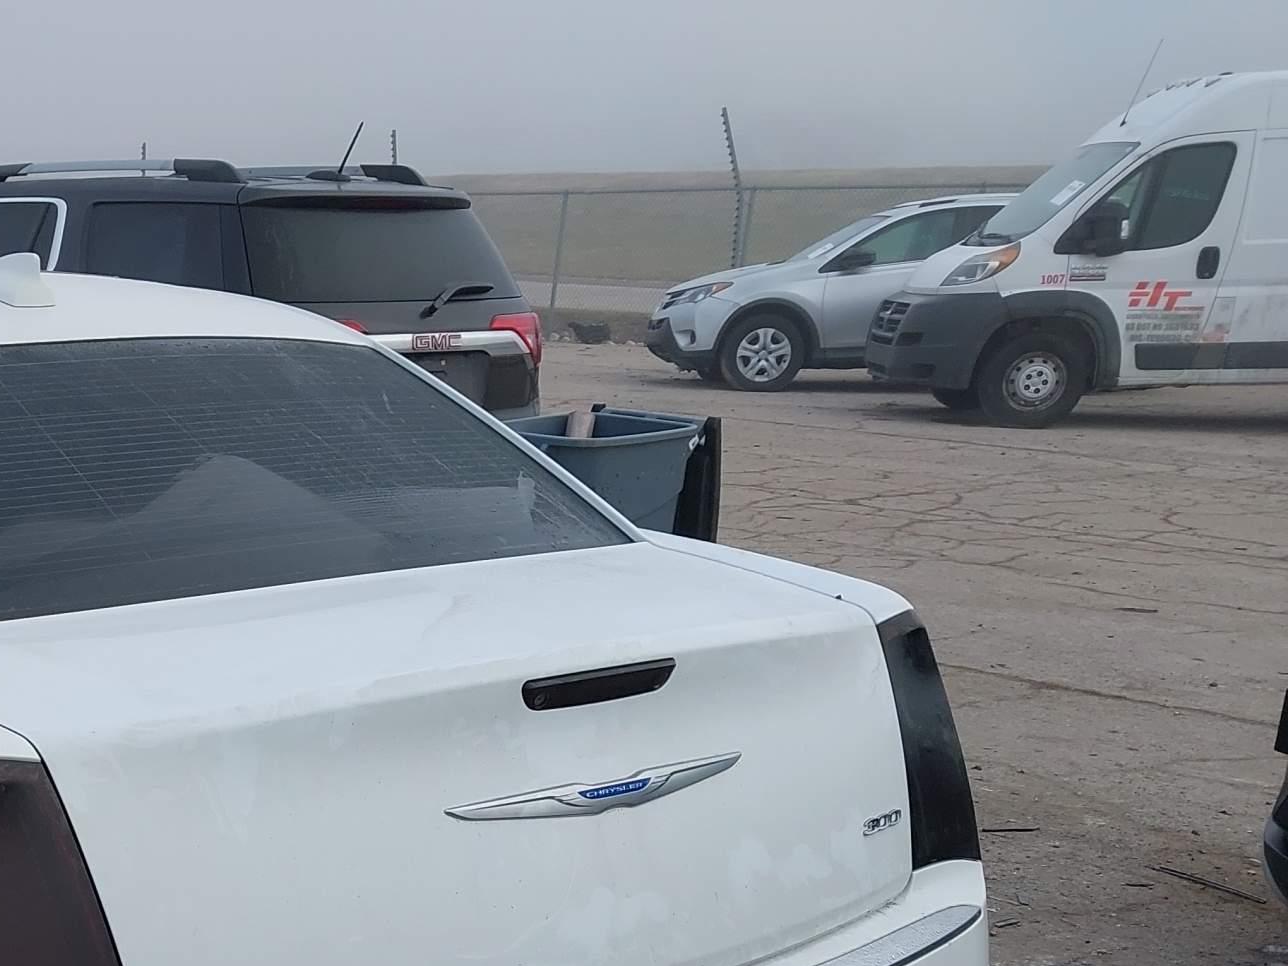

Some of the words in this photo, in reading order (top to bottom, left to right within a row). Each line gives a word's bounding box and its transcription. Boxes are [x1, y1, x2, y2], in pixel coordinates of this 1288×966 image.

[1040, 274, 1065, 284] 1007
[412, 334, 462, 351] GMC
[585, 782, 644, 798] CHRYSLER
[863, 809, 902, 836] 300
